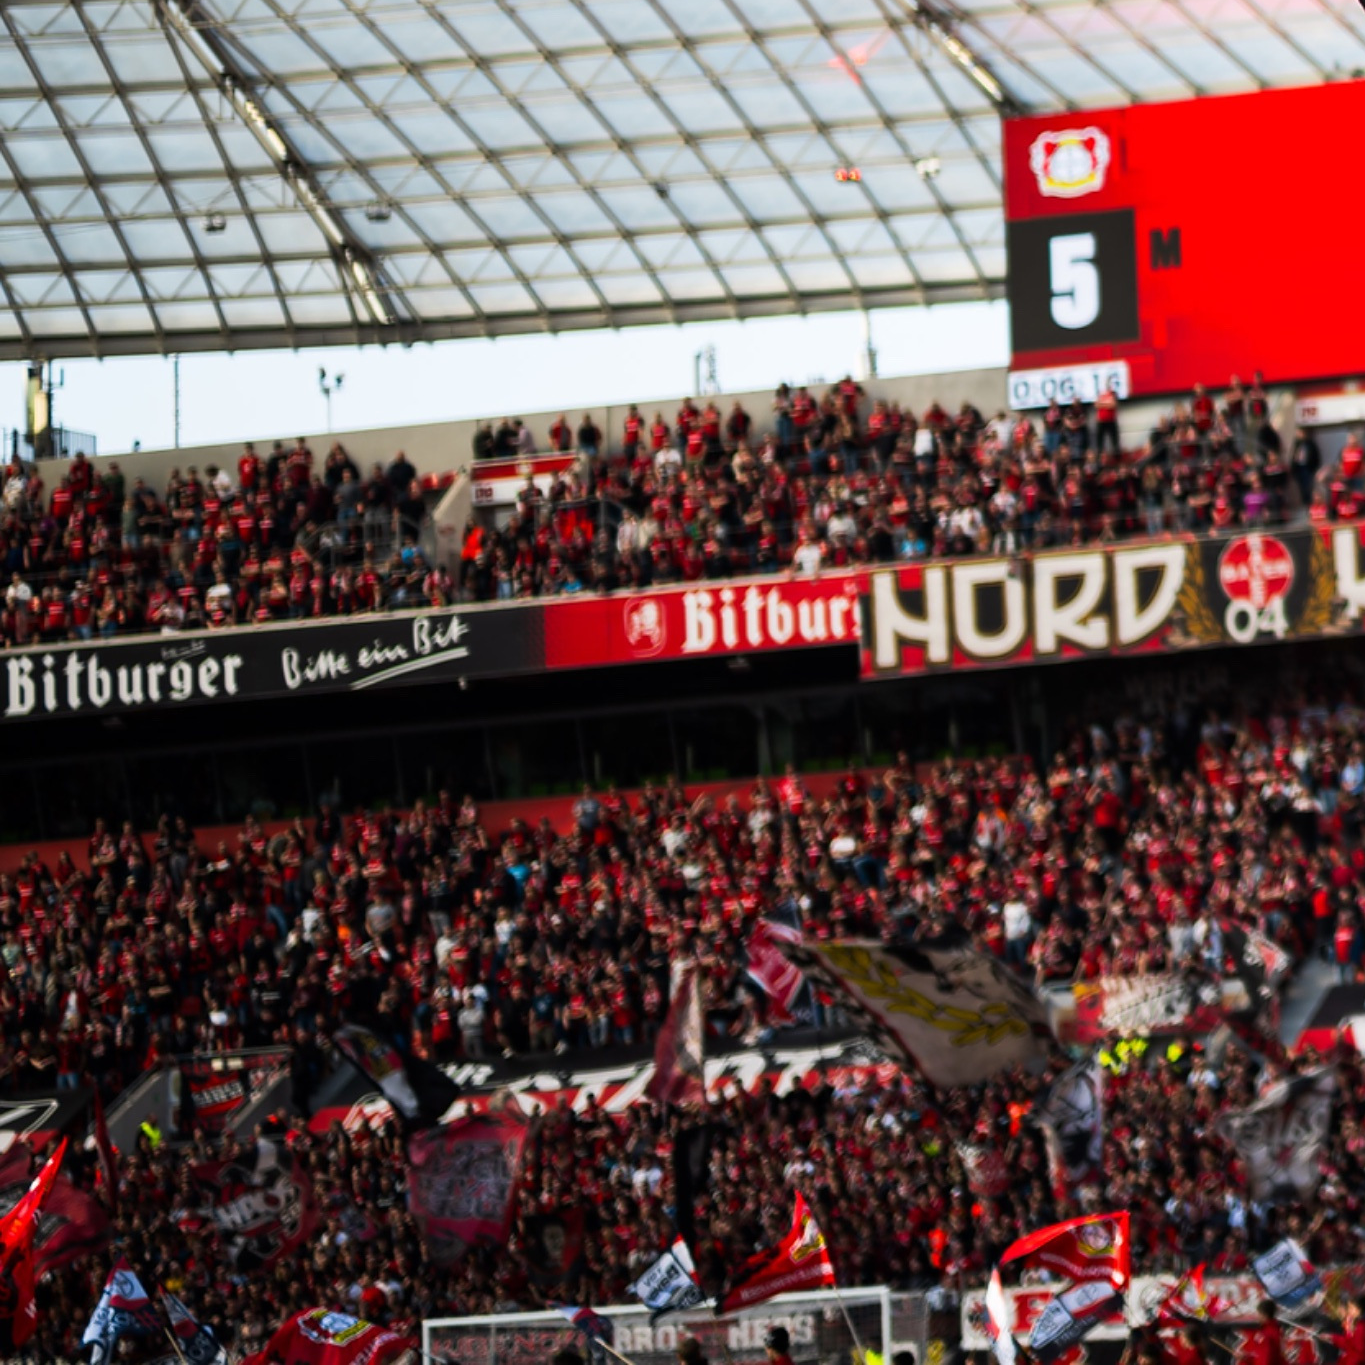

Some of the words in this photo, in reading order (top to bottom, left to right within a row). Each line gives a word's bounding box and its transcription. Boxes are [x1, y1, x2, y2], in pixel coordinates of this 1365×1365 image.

[1048, 231, 1100, 330] 5
[1149, 226, 1183, 270] M
[872, 544, 1186, 669] NORD
[1225, 597, 1289, 643] 04
[4, 651, 244, 718] Bitburger
[281, 646, 350, 691] Bitte
[357, 643, 408, 671] ein
[412, 615, 469, 655] Bit
